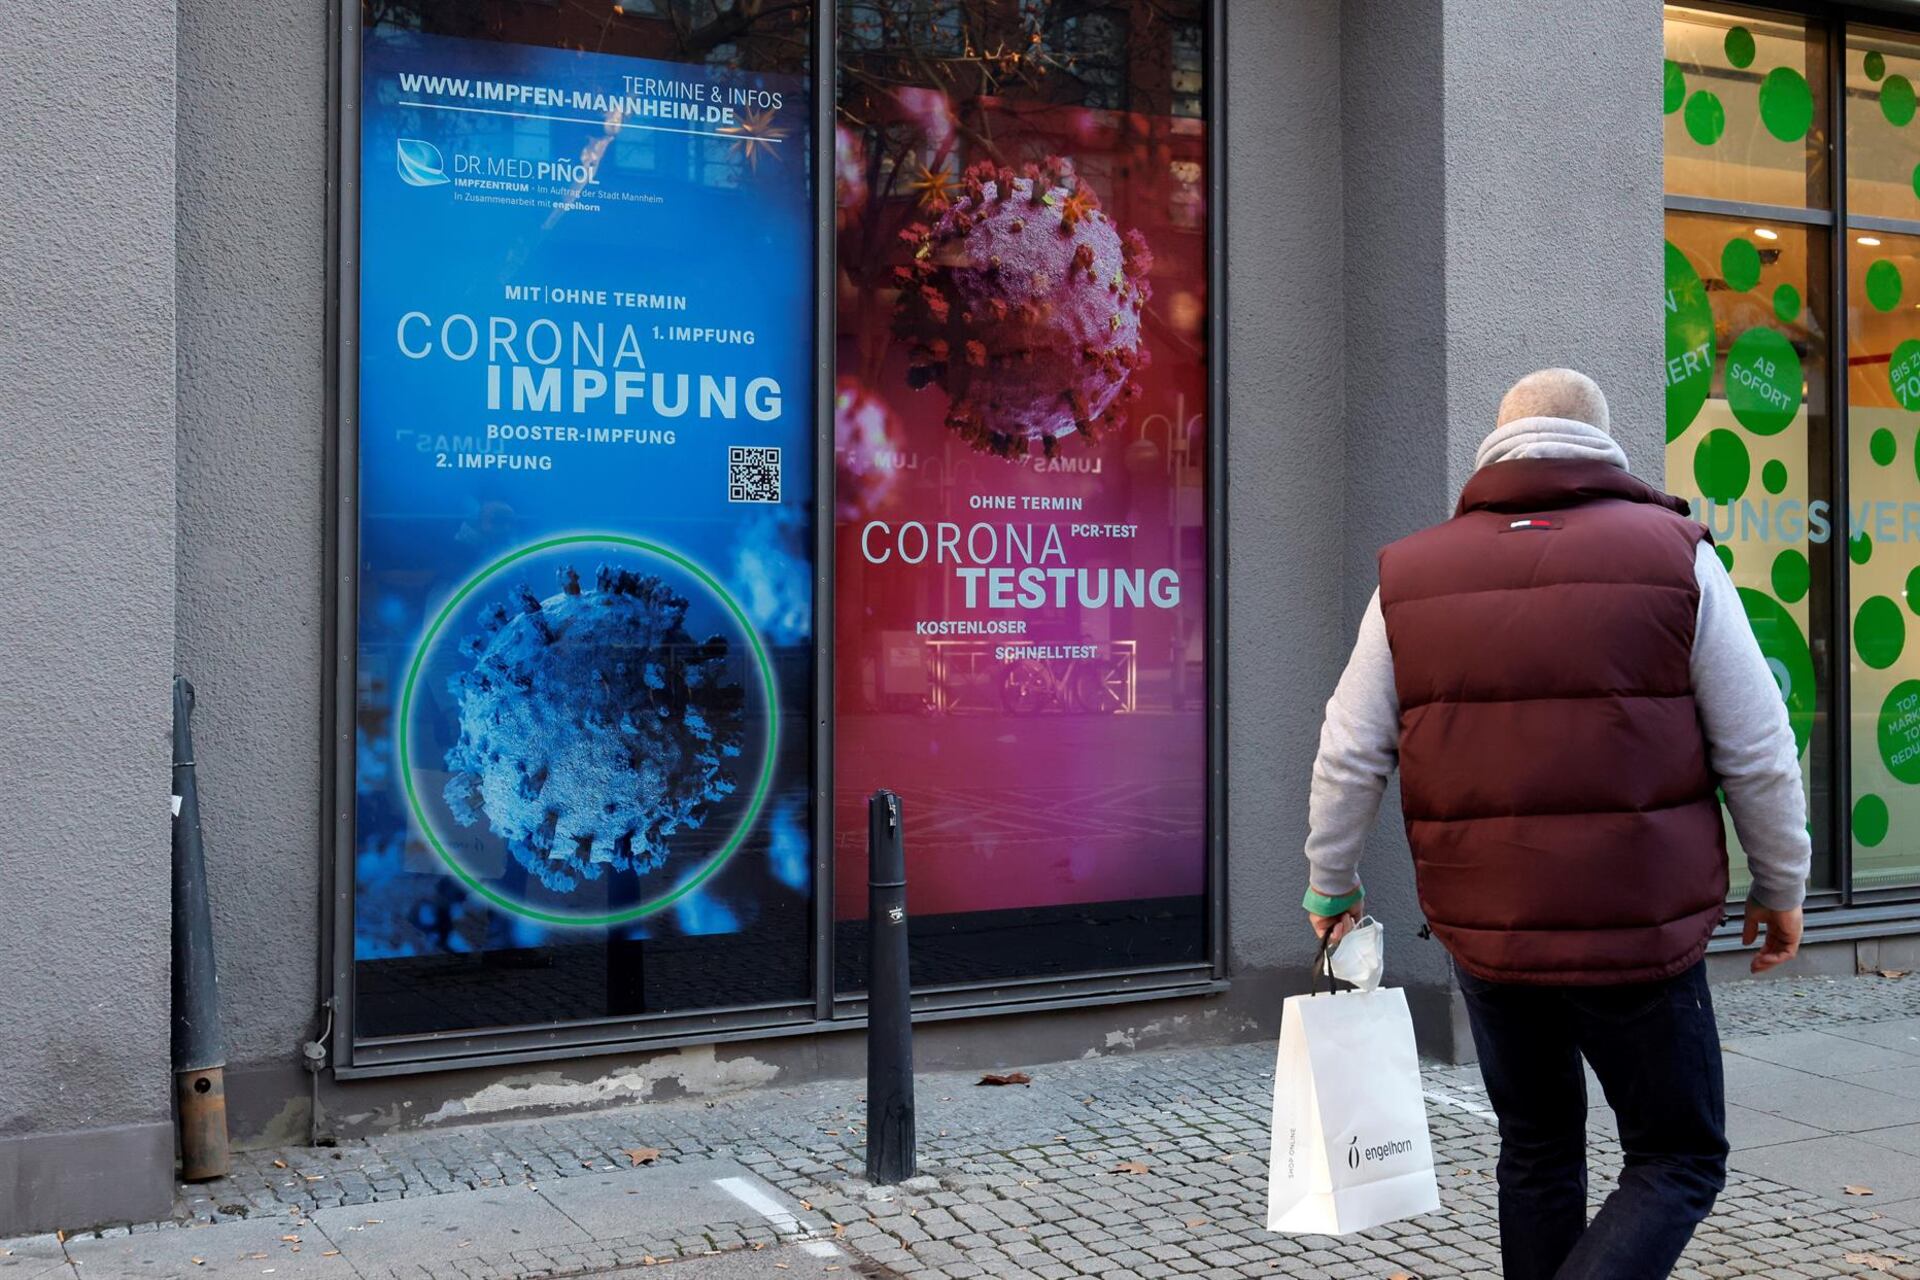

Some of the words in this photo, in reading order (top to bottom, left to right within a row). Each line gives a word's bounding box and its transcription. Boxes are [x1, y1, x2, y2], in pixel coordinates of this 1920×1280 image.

[399, 72, 734, 124] WWW.IMPFEN-MANNHEIM.DE
[622, 75, 704, 101] TERMINE
[710, 86, 722, 103] &
[729, 88, 783, 109] INFOS
[537, 158, 600, 185] PIÑOL
[454, 178, 529, 192] IMPFZENTRUM
[537, 185, 548, 194] Im
[550, 186, 580, 198] Auftrag
[582, 189, 598, 198] der
[599, 190, 620, 200] Stadt
[622, 192, 664, 203] Mannheim
[454, 192, 463, 200] In
[465, 193, 535, 206] Zusammenarbeit
[537, 199, 551, 208] mit
[552, 201, 600, 212] engelhorn
[551, 288, 607, 306] OHNE
[613, 292, 687, 310] TERMIN
[397, 311, 645, 369] CORONA
[652, 326, 664, 340] 1.
[669, 327, 755, 345] IMPFUNG
[1753, 356, 1775, 378] AB
[1891, 361, 1910, 383] BIS
[487, 365, 782, 421] IMPFUNG
[1731, 363, 1791, 410] SOFORT
[487, 424, 676, 445] BOOSTER-IMPFUNG
[436, 453, 453, 468] 2.
[458, 453, 552, 471] IMPFUNG
[969, 495, 1016, 510] OHNE
[1021, 496, 1082, 511] TERMIN
[861, 520, 1067, 564] CORONA
[1071, 524, 1137, 538] PCR-TEST
[956, 567, 1180, 609] TESTUNG
[916, 621, 1026, 635] KOSTENLOSER
[995, 645, 1098, 661] SCHNELLTEST
[1896, 694, 1917, 712] TOP
[1888, 707, 1920, 735] MARK
[1365, 1138, 1412, 1161] engelhorn
